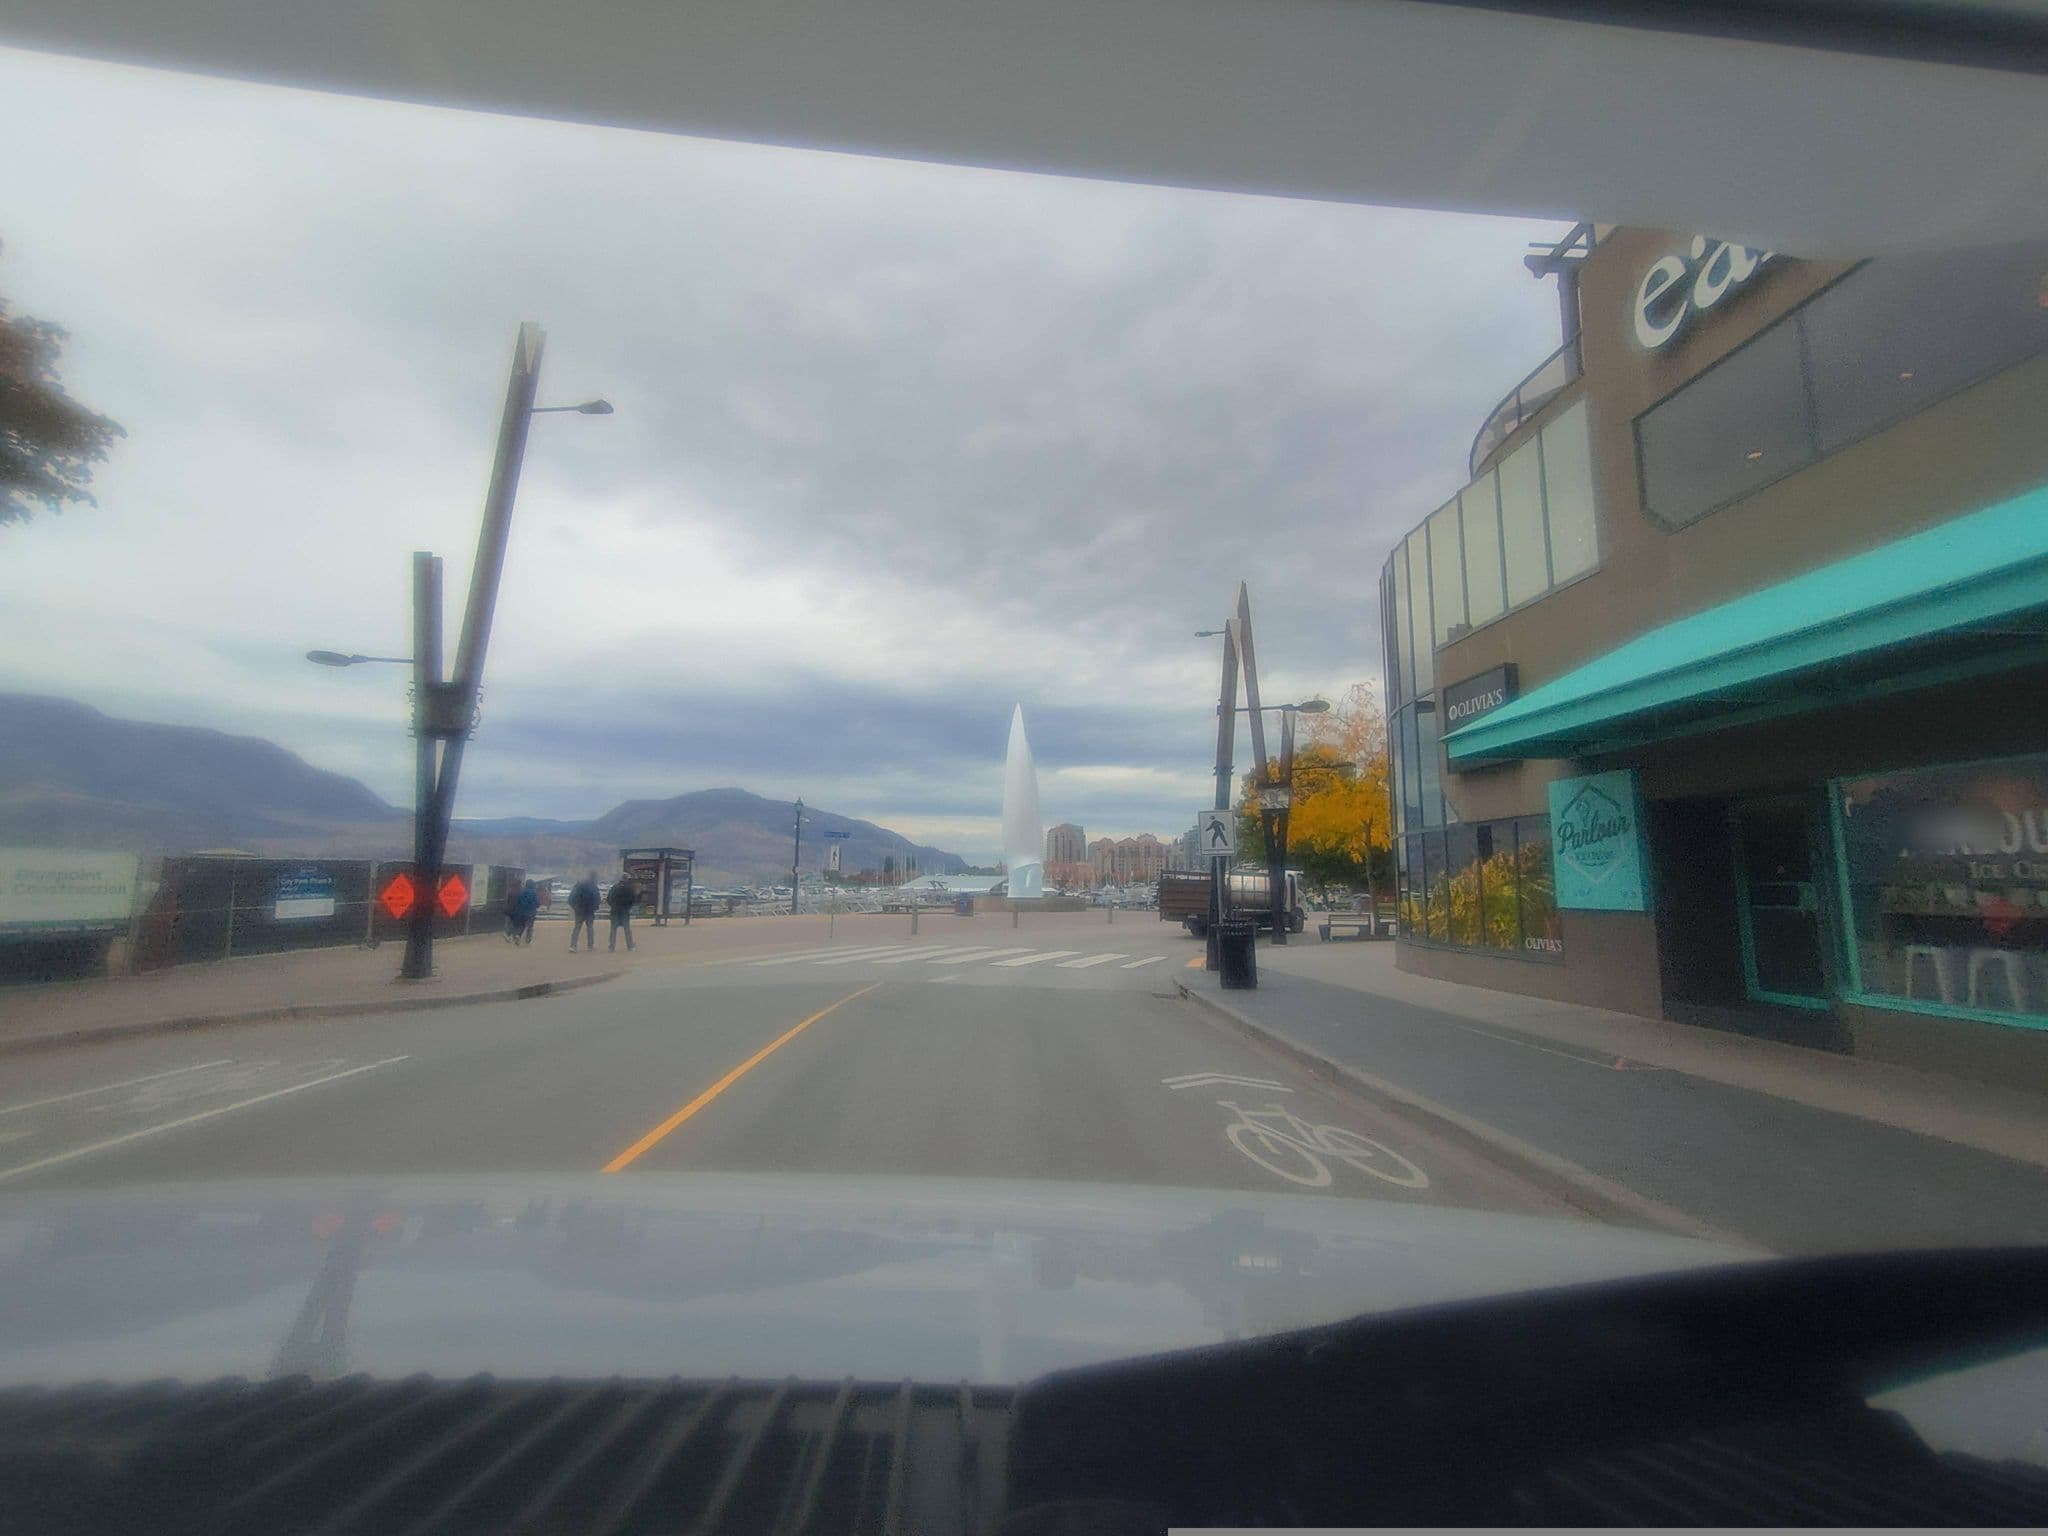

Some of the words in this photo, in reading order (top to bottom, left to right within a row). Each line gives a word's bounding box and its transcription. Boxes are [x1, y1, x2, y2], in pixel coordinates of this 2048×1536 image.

[1634, 234, 1776, 348] e'a
[1457, 688, 1503, 718] OLIVIA'S
[1557, 809, 1631, 855] Parlour
